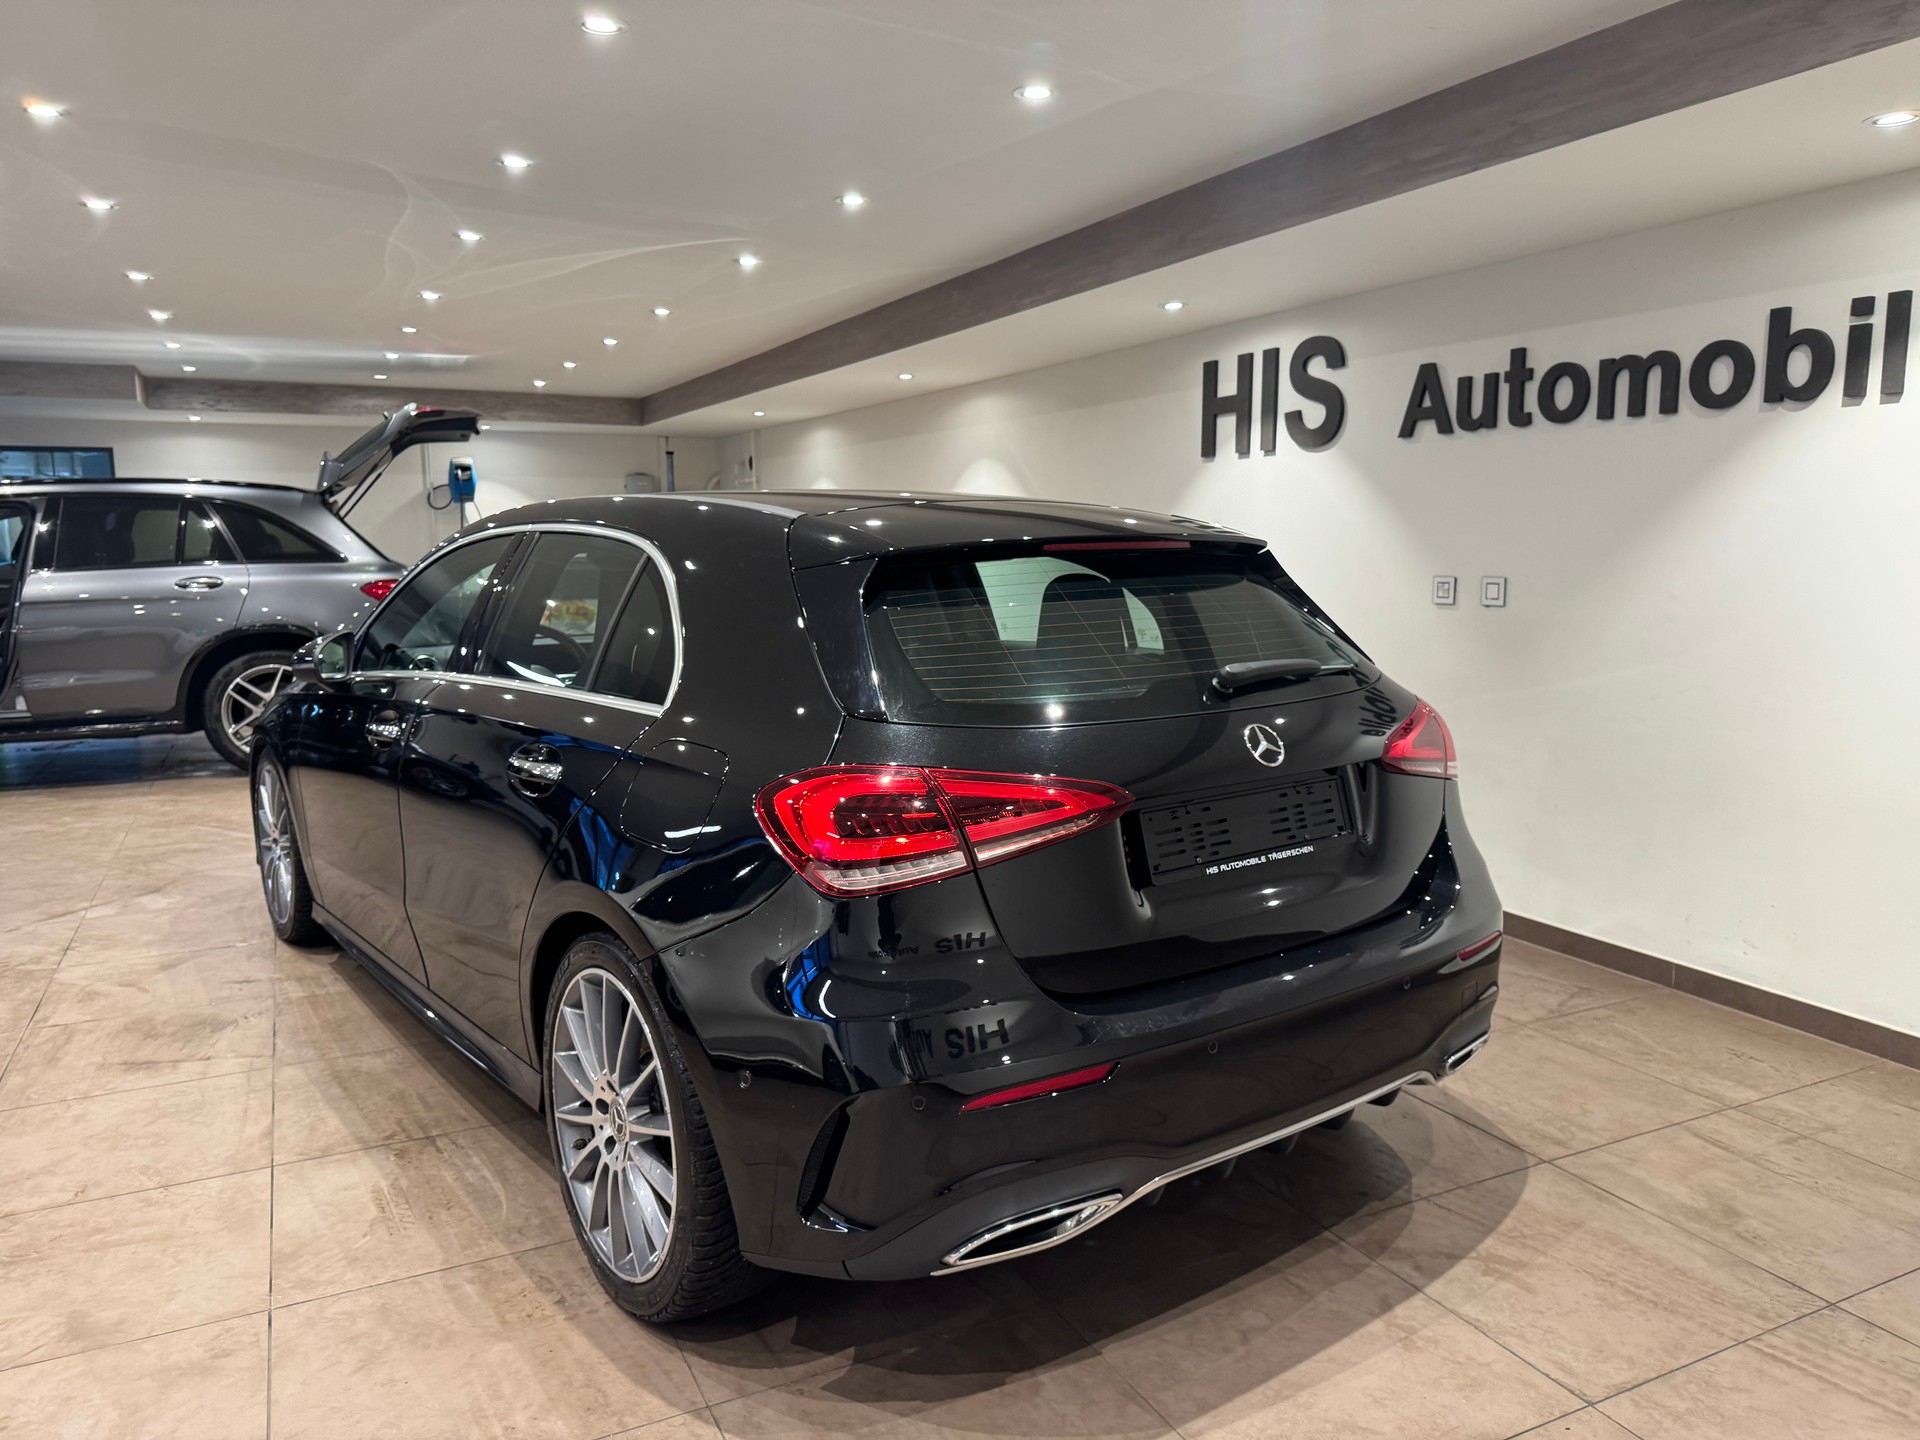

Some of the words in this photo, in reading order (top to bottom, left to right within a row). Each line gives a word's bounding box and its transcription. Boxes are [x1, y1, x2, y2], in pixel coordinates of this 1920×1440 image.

[1201, 336, 1346, 459] HIS
[1397, 290, 1914, 439] Automobil
[1205, 866, 1219, 875] HIS
[1219, 855, 1267, 872] AUTOMOBILE
